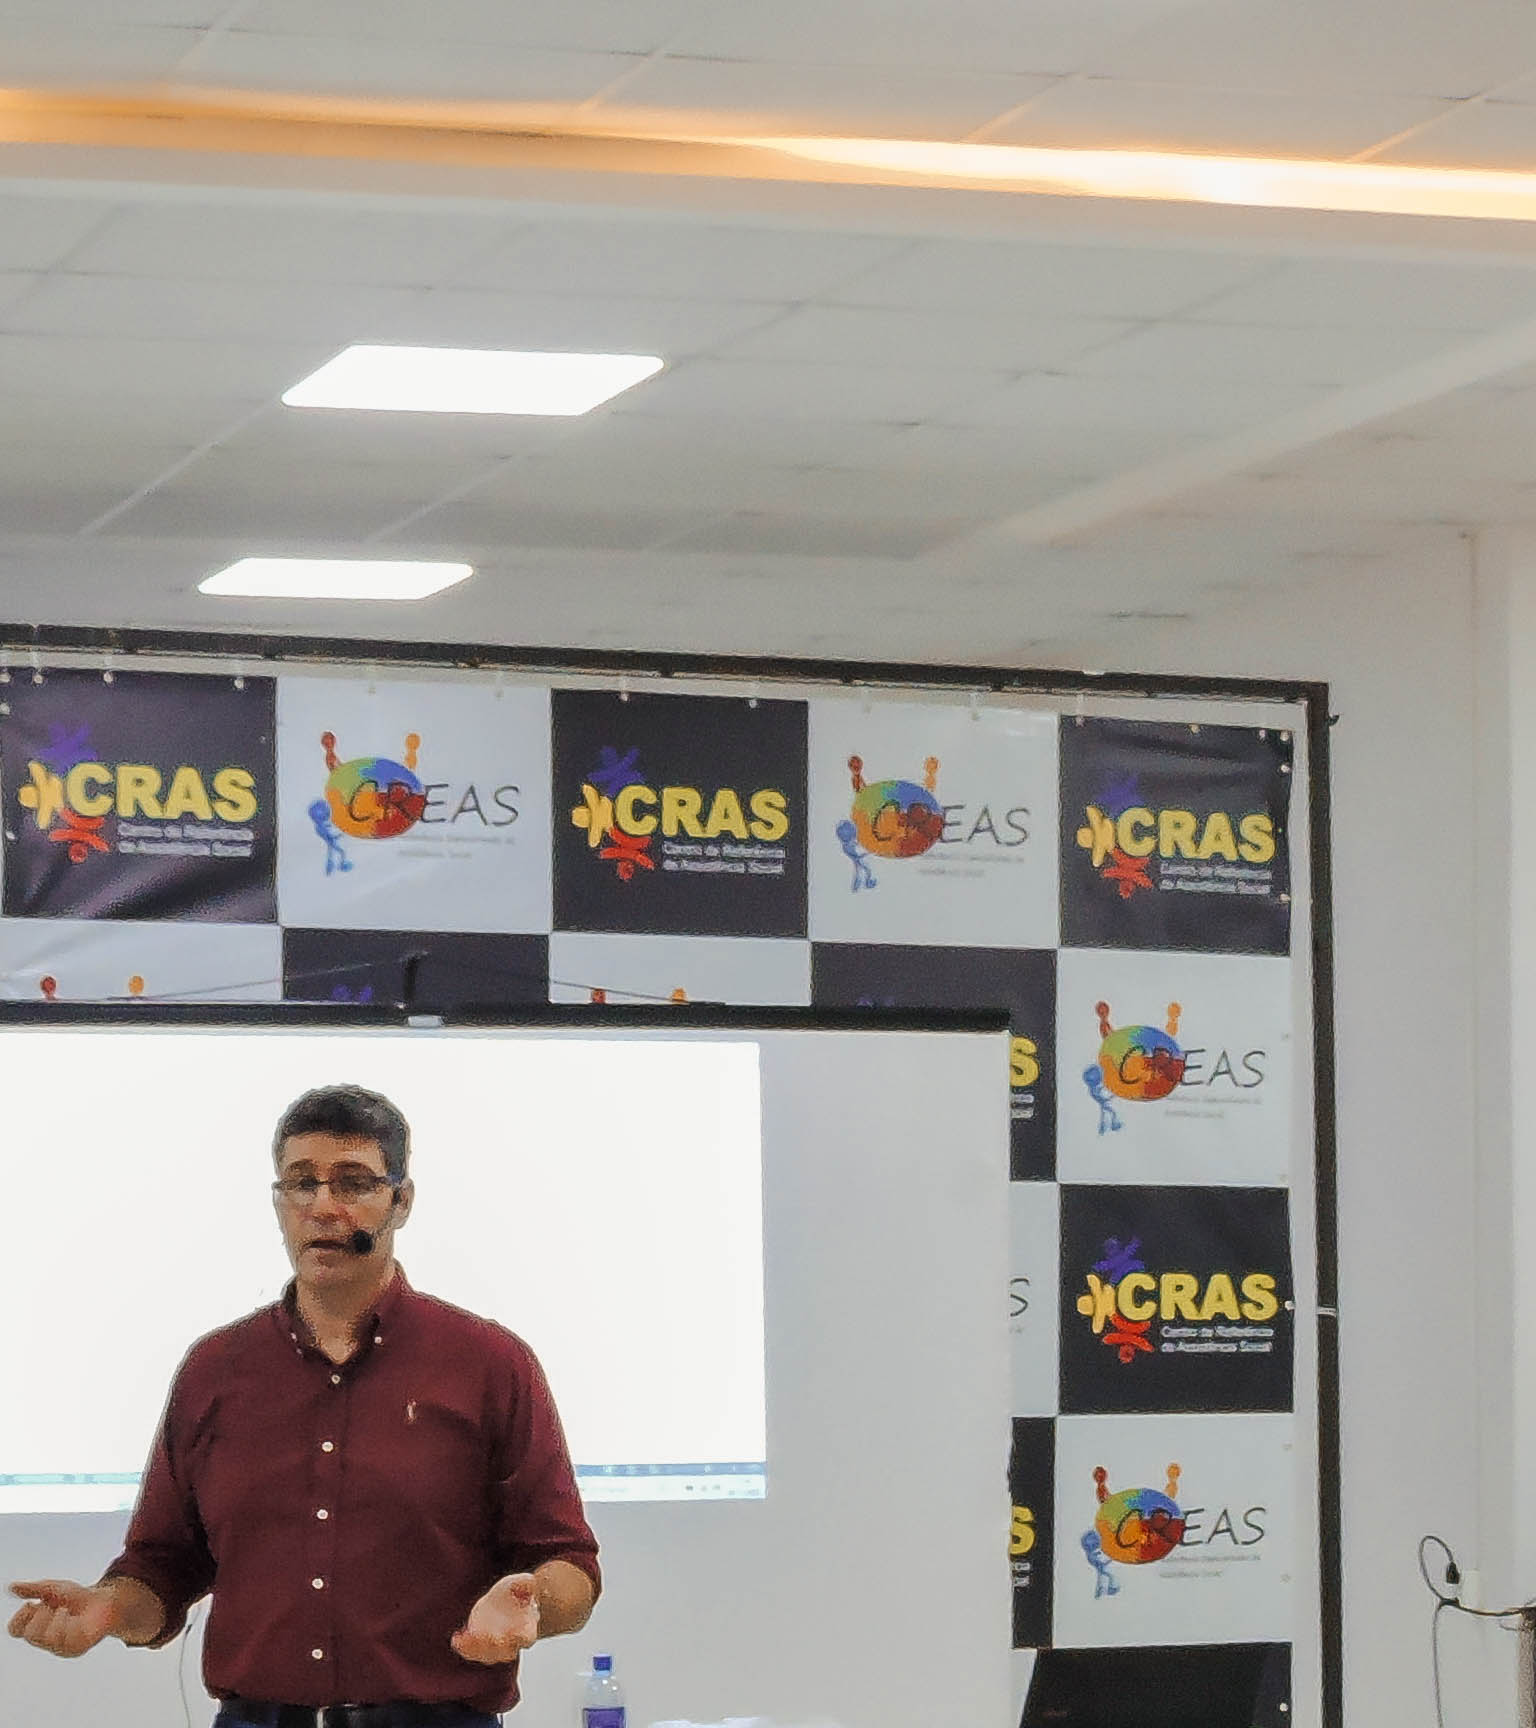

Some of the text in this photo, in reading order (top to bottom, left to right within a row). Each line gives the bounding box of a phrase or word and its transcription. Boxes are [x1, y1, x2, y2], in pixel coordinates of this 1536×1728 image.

[66, 762, 258, 822] CRAS
[349, 779, 520, 827] CREAS
[615, 784, 789, 841] CRAS
[872, 800, 1031, 846] CREAS
[1117, 807, 1277, 864] CRAS
[1119, 1046, 1266, 1088] CREAS
[1117, 1272, 1279, 1321] CRAS
[1116, 1507, 1267, 1548] CREAS
